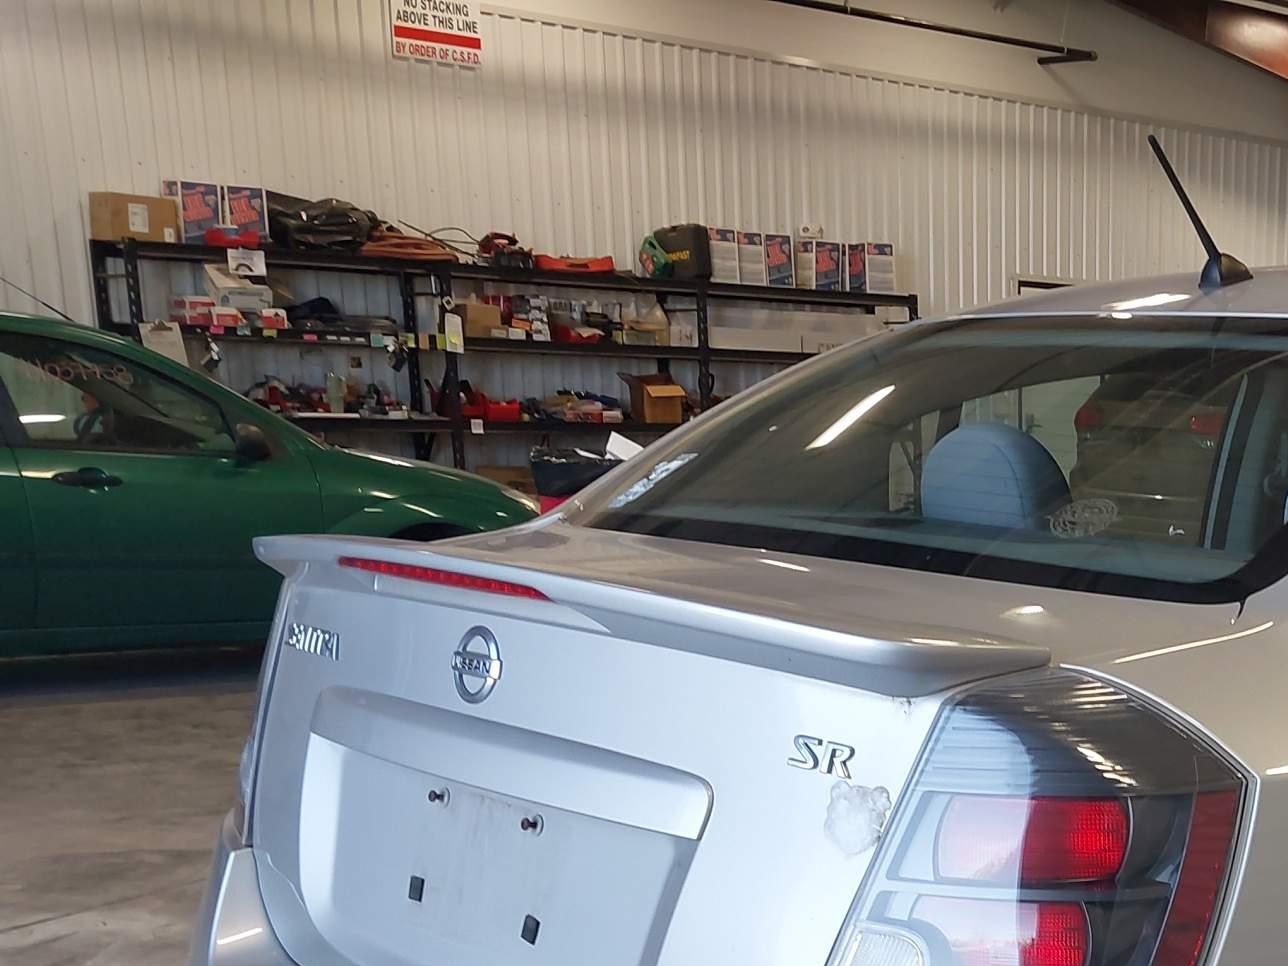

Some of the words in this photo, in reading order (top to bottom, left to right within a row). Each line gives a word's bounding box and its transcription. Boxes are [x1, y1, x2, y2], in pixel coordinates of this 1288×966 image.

[420, 0, 469, 17] STACKING
[396, 9, 429, 26] ABOVE
[432, 15, 454, 30] THIS
[456, 20, 479, 34] LINE
[395, 41, 406, 54] BY
[408, 43, 437, 58] ORDER
[439, 47, 450, 60] OF
[452, 49, 481, 65] C.S.F.D.
[451, 654, 491, 676] NISSAN
[786, 734, 856, 779] SR
